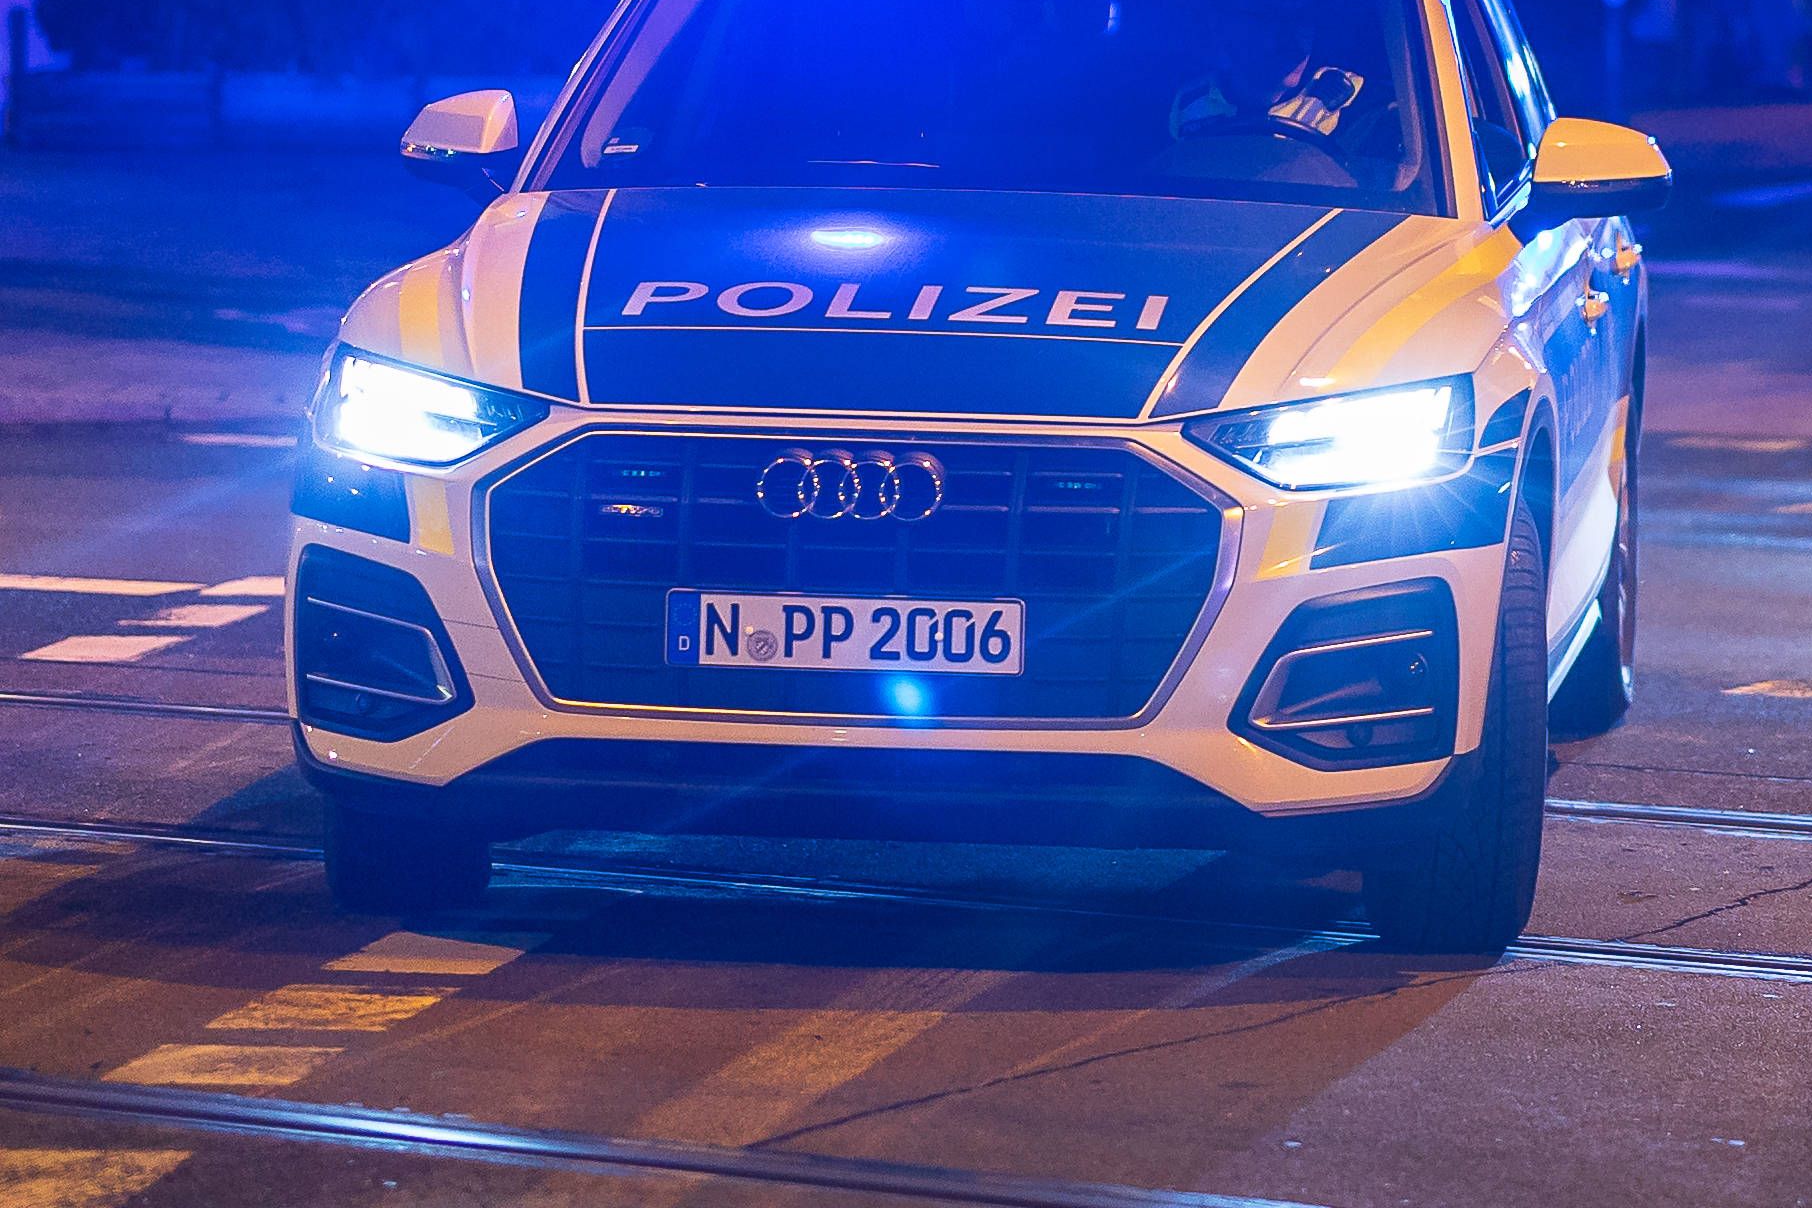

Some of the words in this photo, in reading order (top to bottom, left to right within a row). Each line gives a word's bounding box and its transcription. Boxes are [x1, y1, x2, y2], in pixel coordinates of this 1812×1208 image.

[622, 281, 1169, 330] POLIZEI
[678, 635, 690, 651] D
[705, 603, 740, 657] N
[783, 604, 854, 659] PP
[869, 607, 1012, 664] 2006
